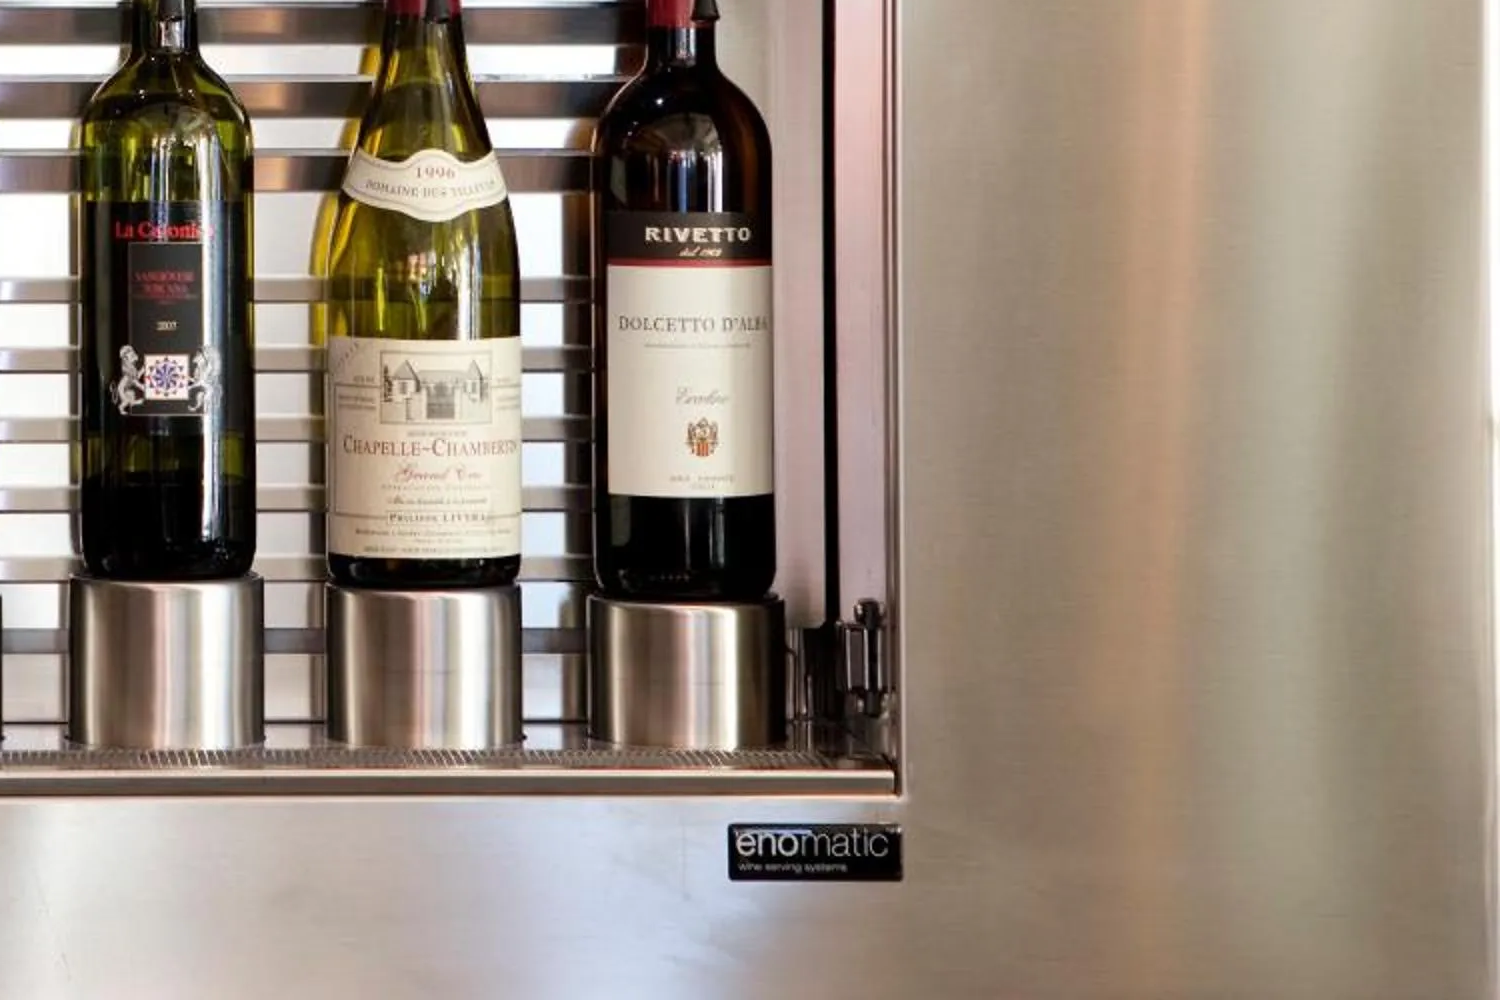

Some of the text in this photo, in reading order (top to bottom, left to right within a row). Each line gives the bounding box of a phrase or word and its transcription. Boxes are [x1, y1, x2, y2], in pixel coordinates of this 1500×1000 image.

[115, 221, 134, 239] La
[645, 227, 751, 243] RIVETTO
[618, 315, 715, 333] DOLCETTO
[736, 829, 889, 858] enomatic
[738, 862, 848, 874] wine serving systems
